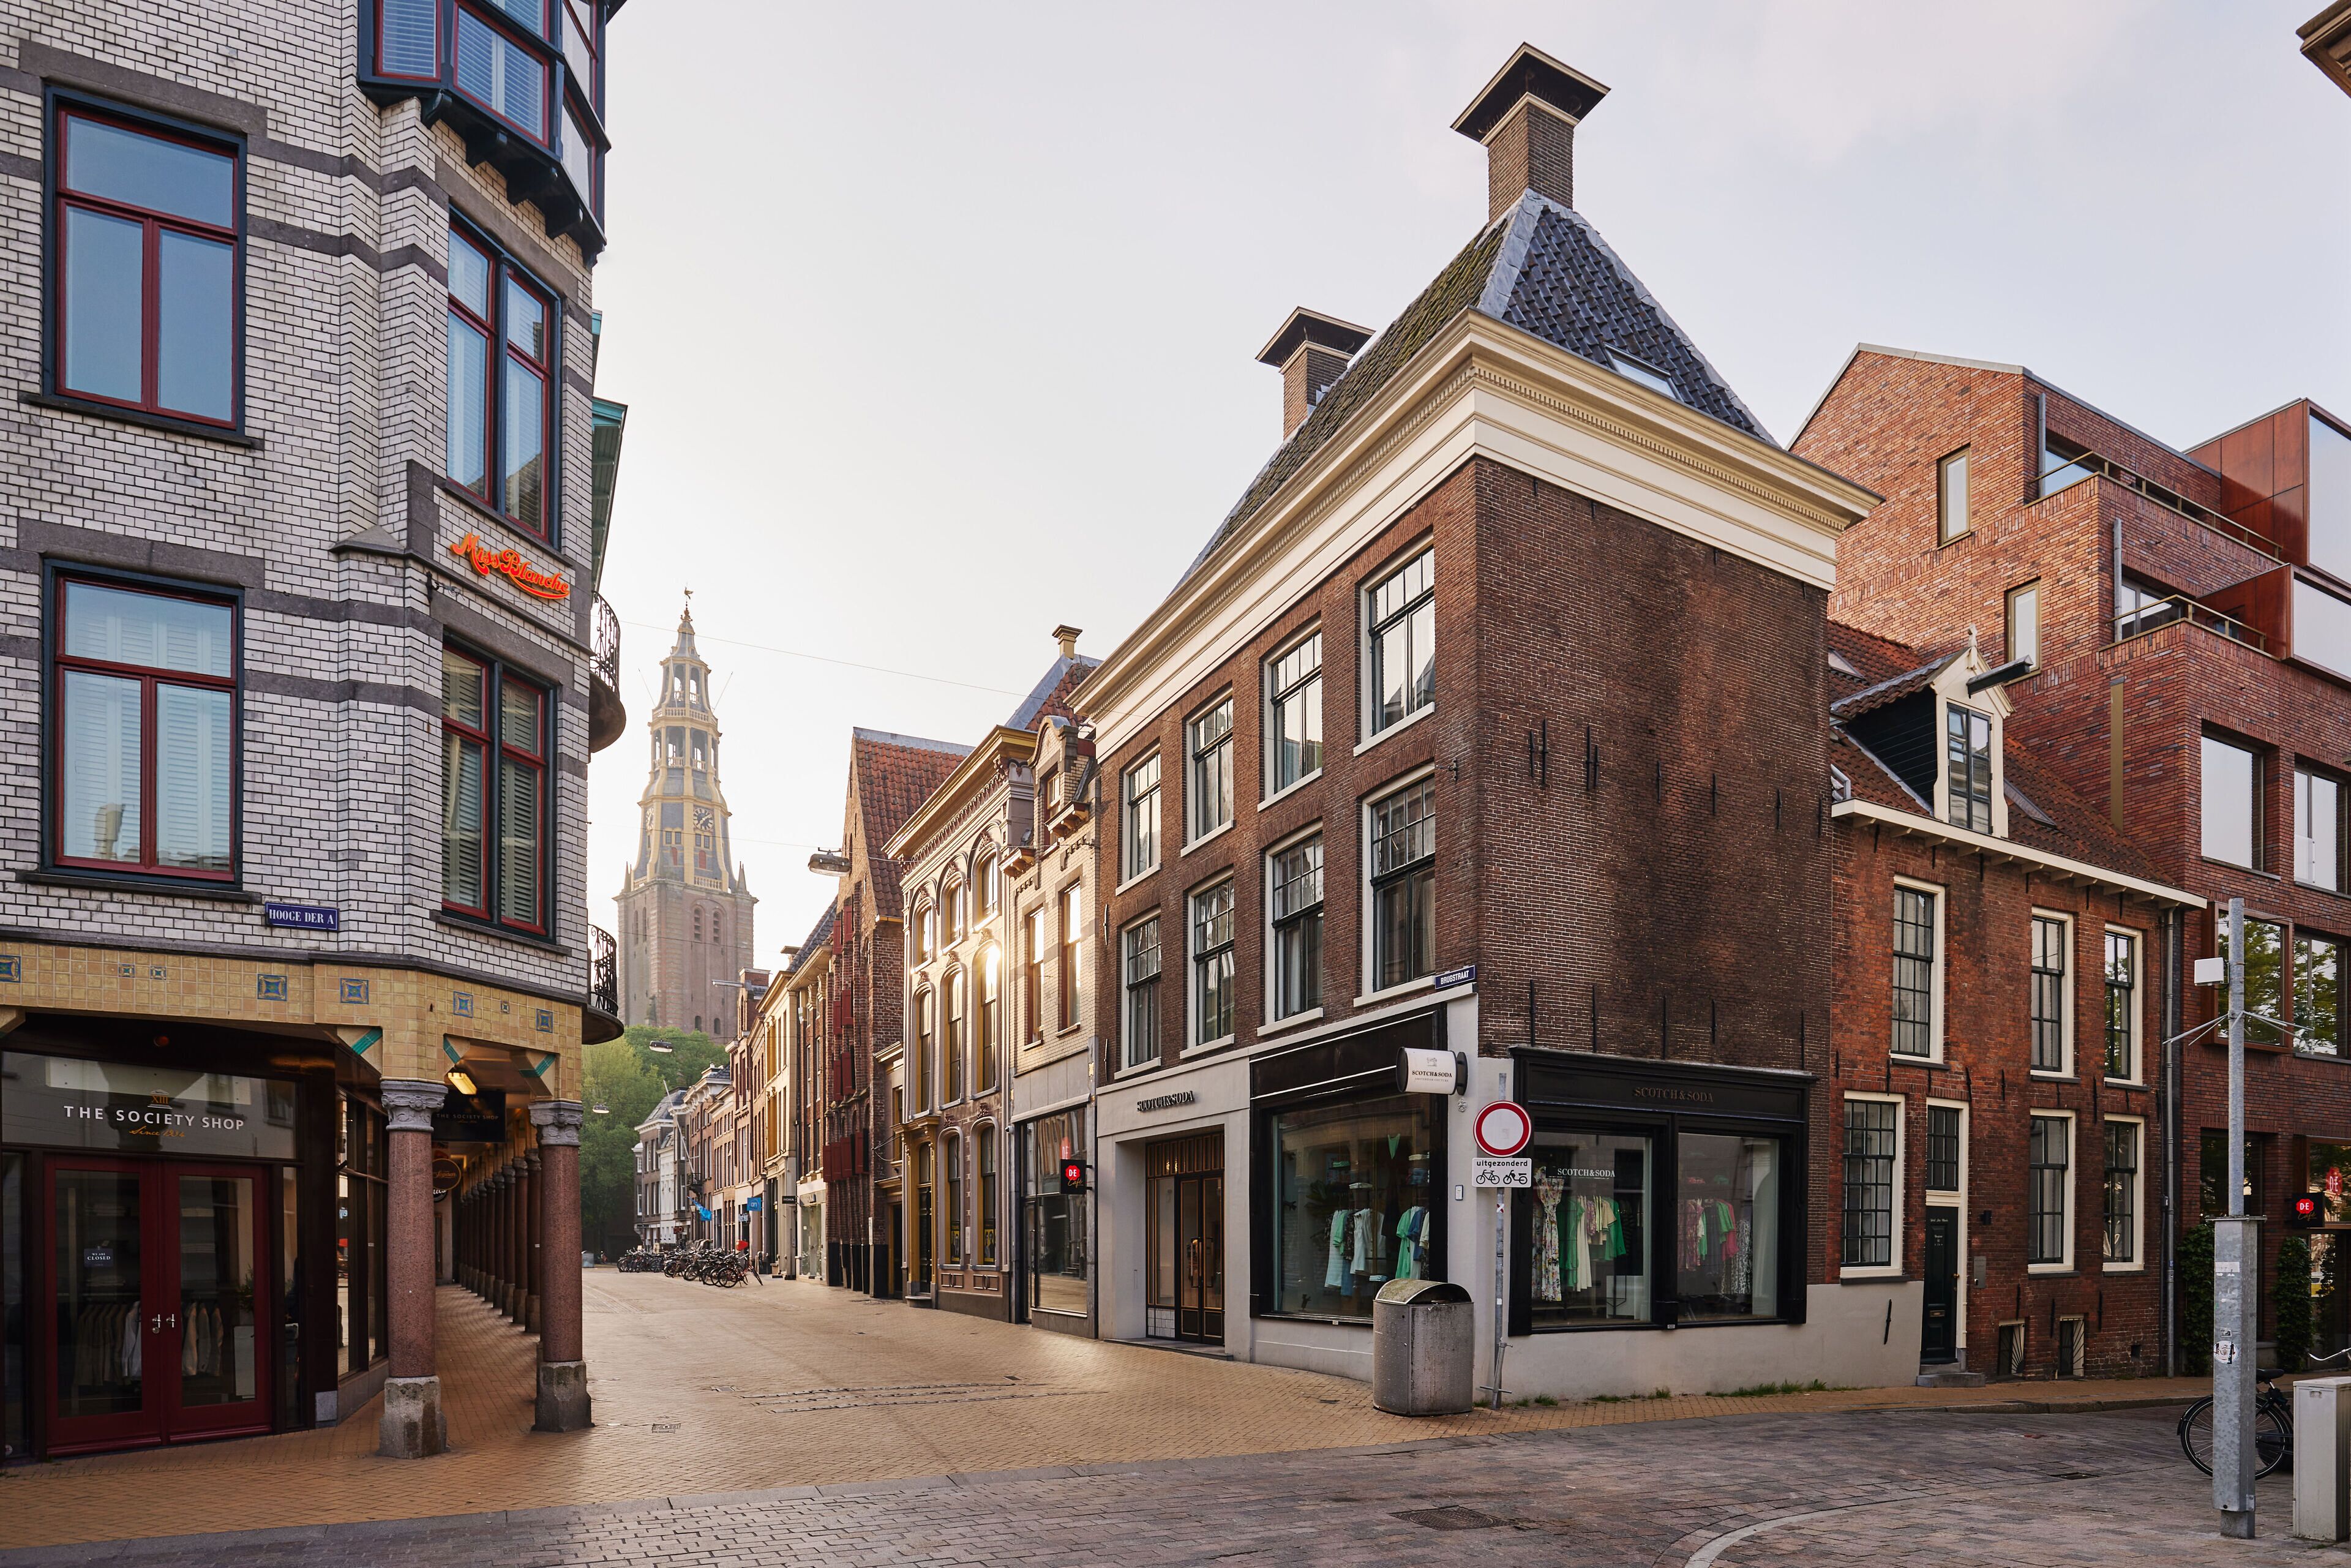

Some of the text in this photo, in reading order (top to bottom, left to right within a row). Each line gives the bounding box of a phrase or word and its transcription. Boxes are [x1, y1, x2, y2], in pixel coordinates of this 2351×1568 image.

[451, 532, 570, 599] Miss Blanche
[269, 909, 334, 925] HOOGE DER A
[1440, 970, 1469, 985] BRUGSTRAAT
[1137, 1090, 1195, 1112] SCOTCH&SODA
[1635, 1087, 1714, 1103] SCOTCH&SODA
[64, 1105, 244, 1130] THE SOCIETY SHOP
[129, 1125, 160, 1136] Since
[1558, 1168, 1615, 1177] SCOTCH&SODA
